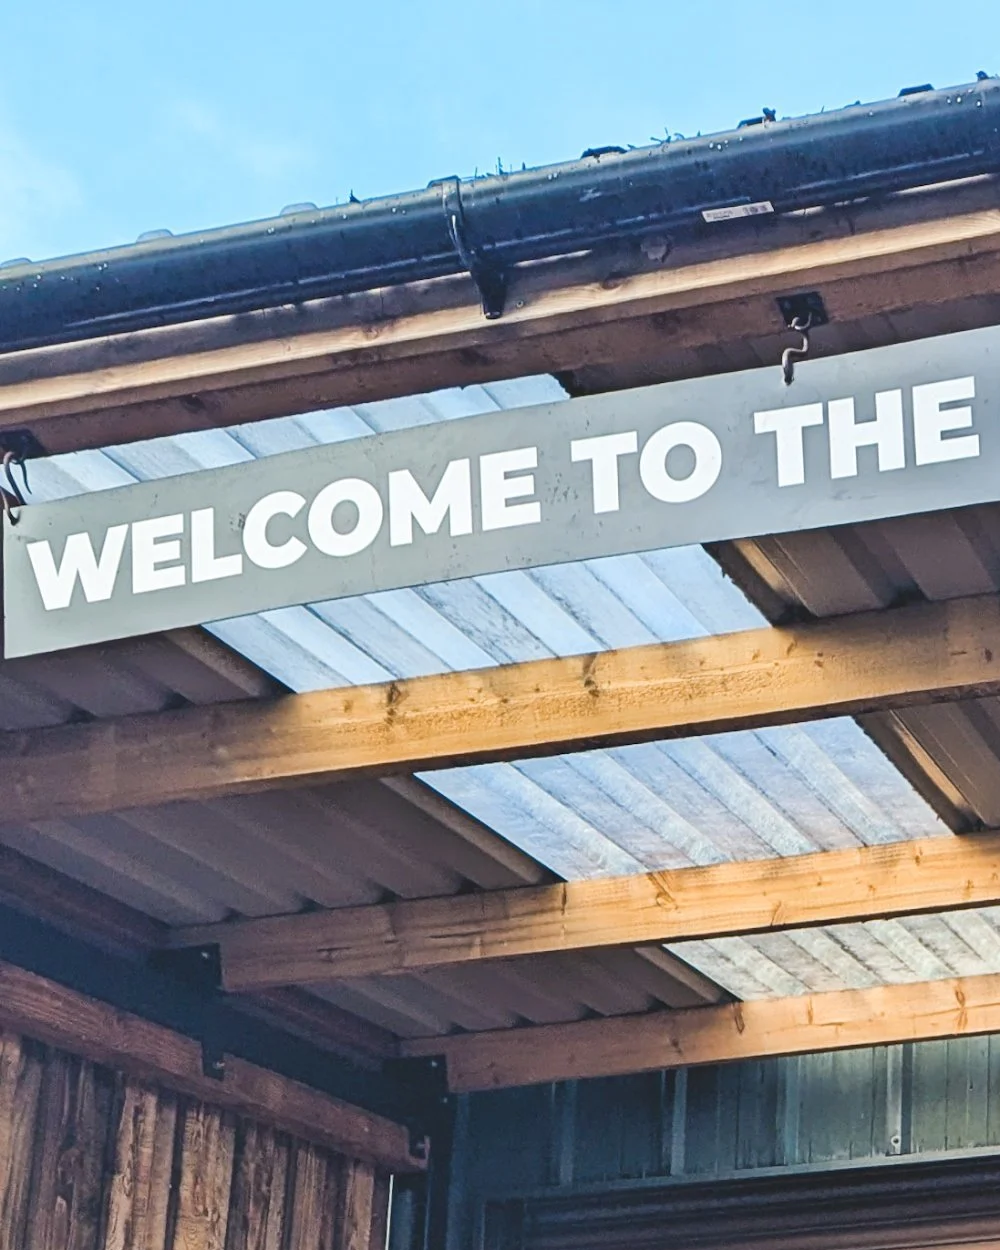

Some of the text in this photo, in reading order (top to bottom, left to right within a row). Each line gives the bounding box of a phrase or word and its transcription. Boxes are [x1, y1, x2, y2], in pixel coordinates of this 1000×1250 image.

[26, 446, 543, 612] WELCOME
[570, 421, 723, 514] TO
[754, 376, 980, 488] THE
